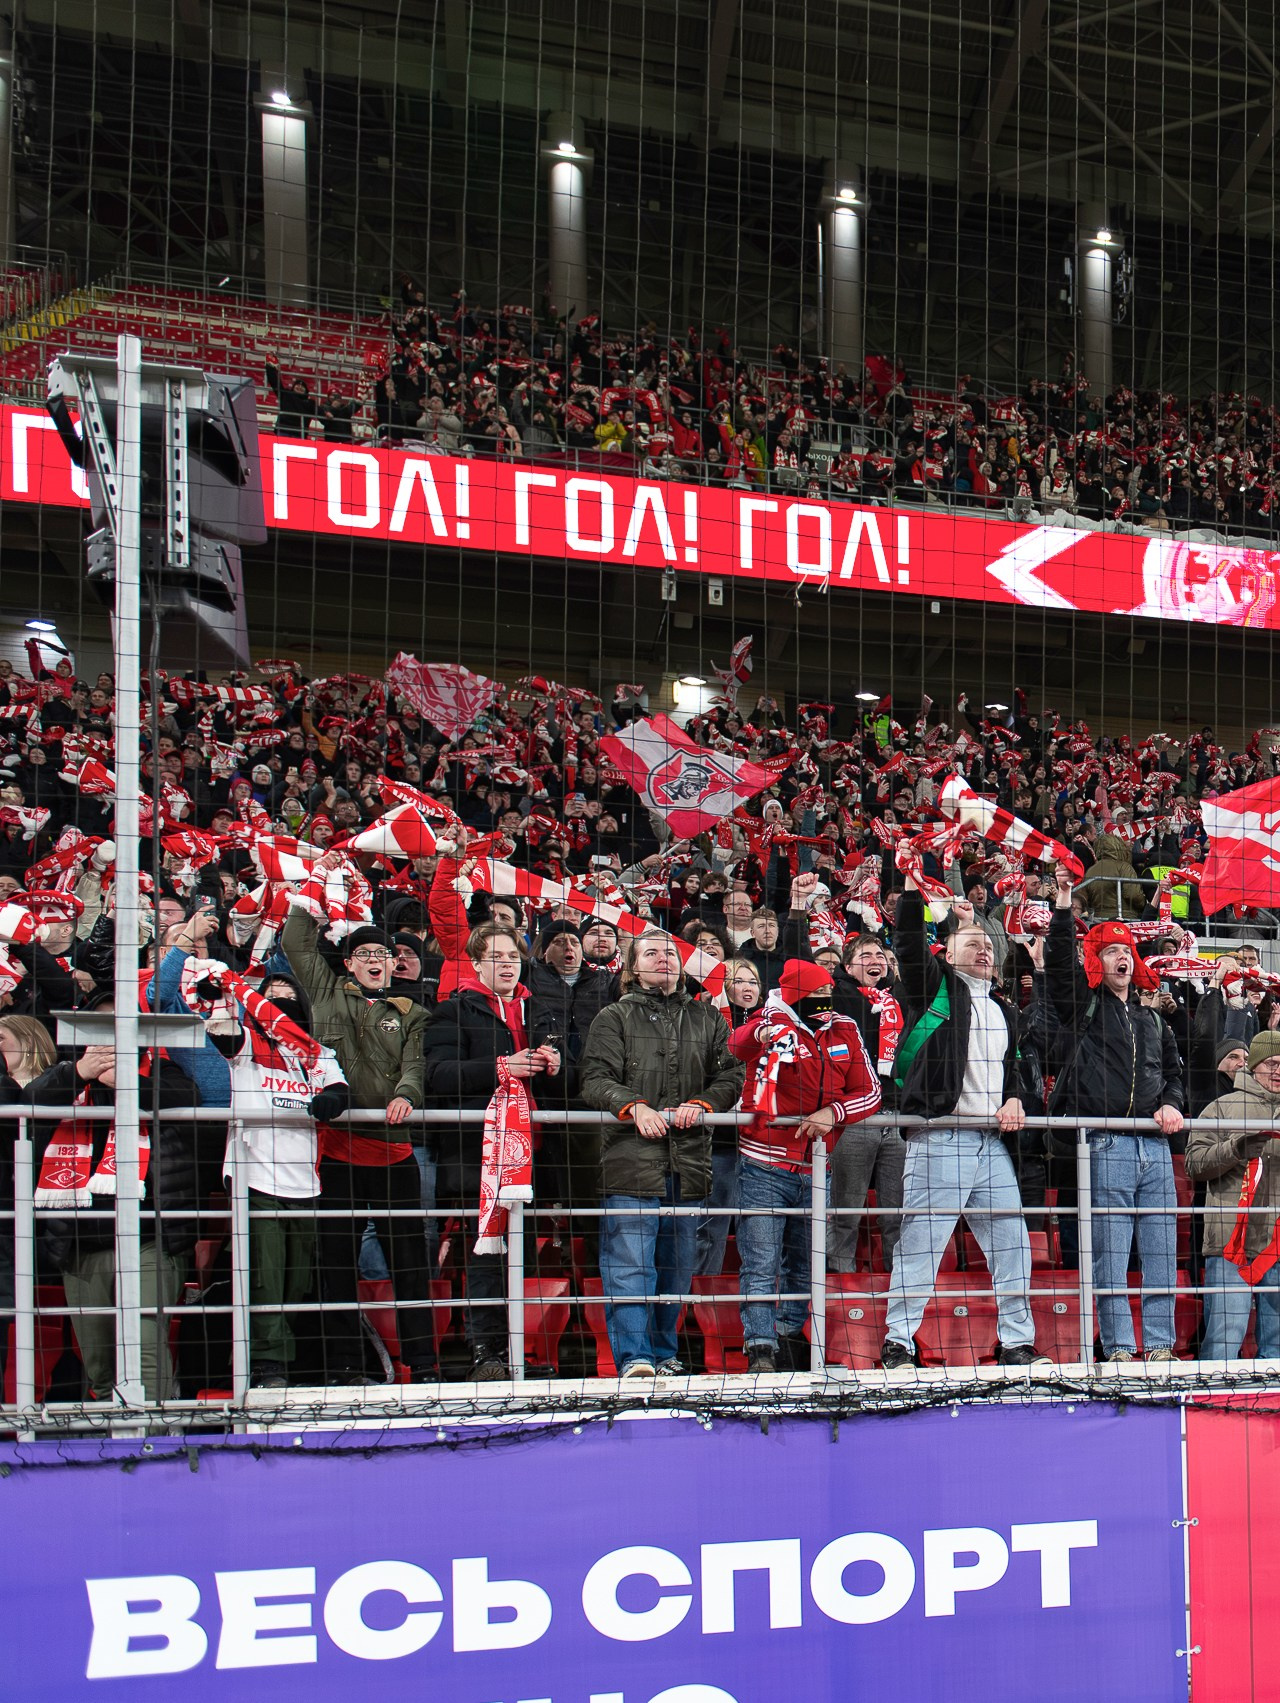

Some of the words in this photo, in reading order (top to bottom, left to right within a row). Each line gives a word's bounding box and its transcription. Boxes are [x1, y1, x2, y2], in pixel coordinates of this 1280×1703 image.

[274, 443, 470, 539] ГОЛ!
[516, 472, 698, 563] ГОЛ!
[740, 498, 910, 585] ГОЛ!
[261, 1076, 323, 1097] ЛУКО
[57, 1146, 79, 1156] 1922
[85, 1557, 552, 1679] ВЕСЬ
[582, 1519, 1098, 1642] СПОРТ
